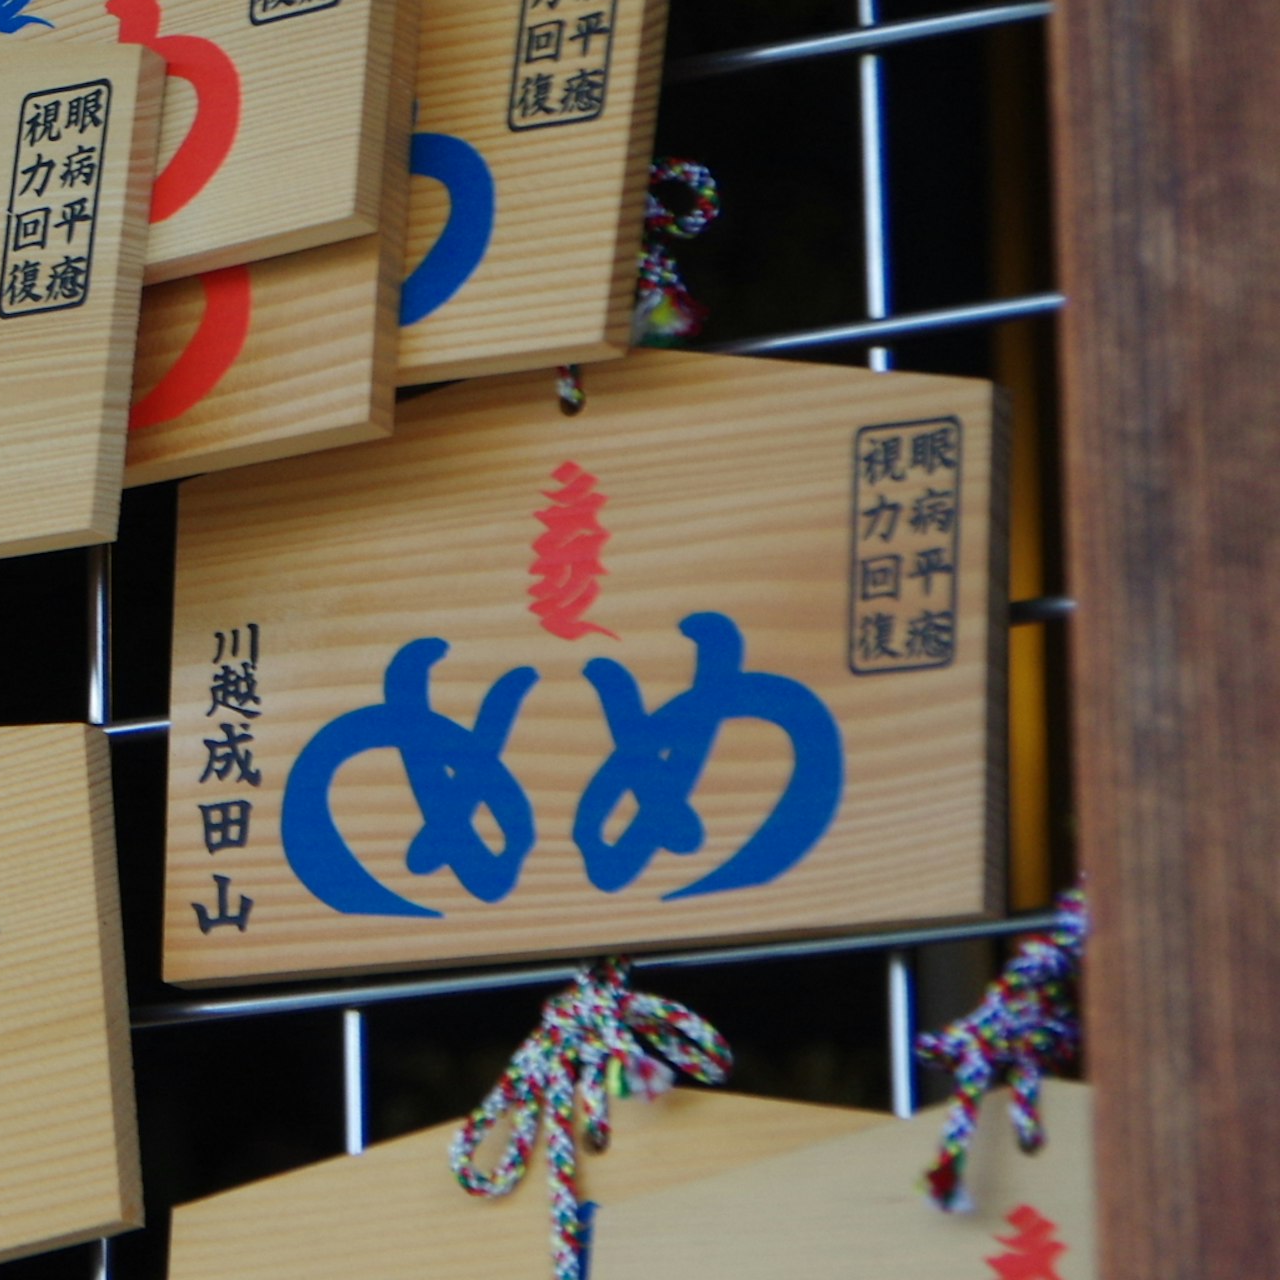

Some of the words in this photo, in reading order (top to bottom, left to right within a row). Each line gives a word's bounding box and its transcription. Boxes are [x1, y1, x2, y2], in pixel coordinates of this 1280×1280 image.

[6, 103, 62, 306] 視力回復
[43, 87, 104, 303] 眼病平癒
[858, 436, 906, 662] 視力回復
[905, 428, 956, 662] 眼病平癒
[191, 622, 260, 933] 川越成田山
[280, 610, 846, 919] めめ
